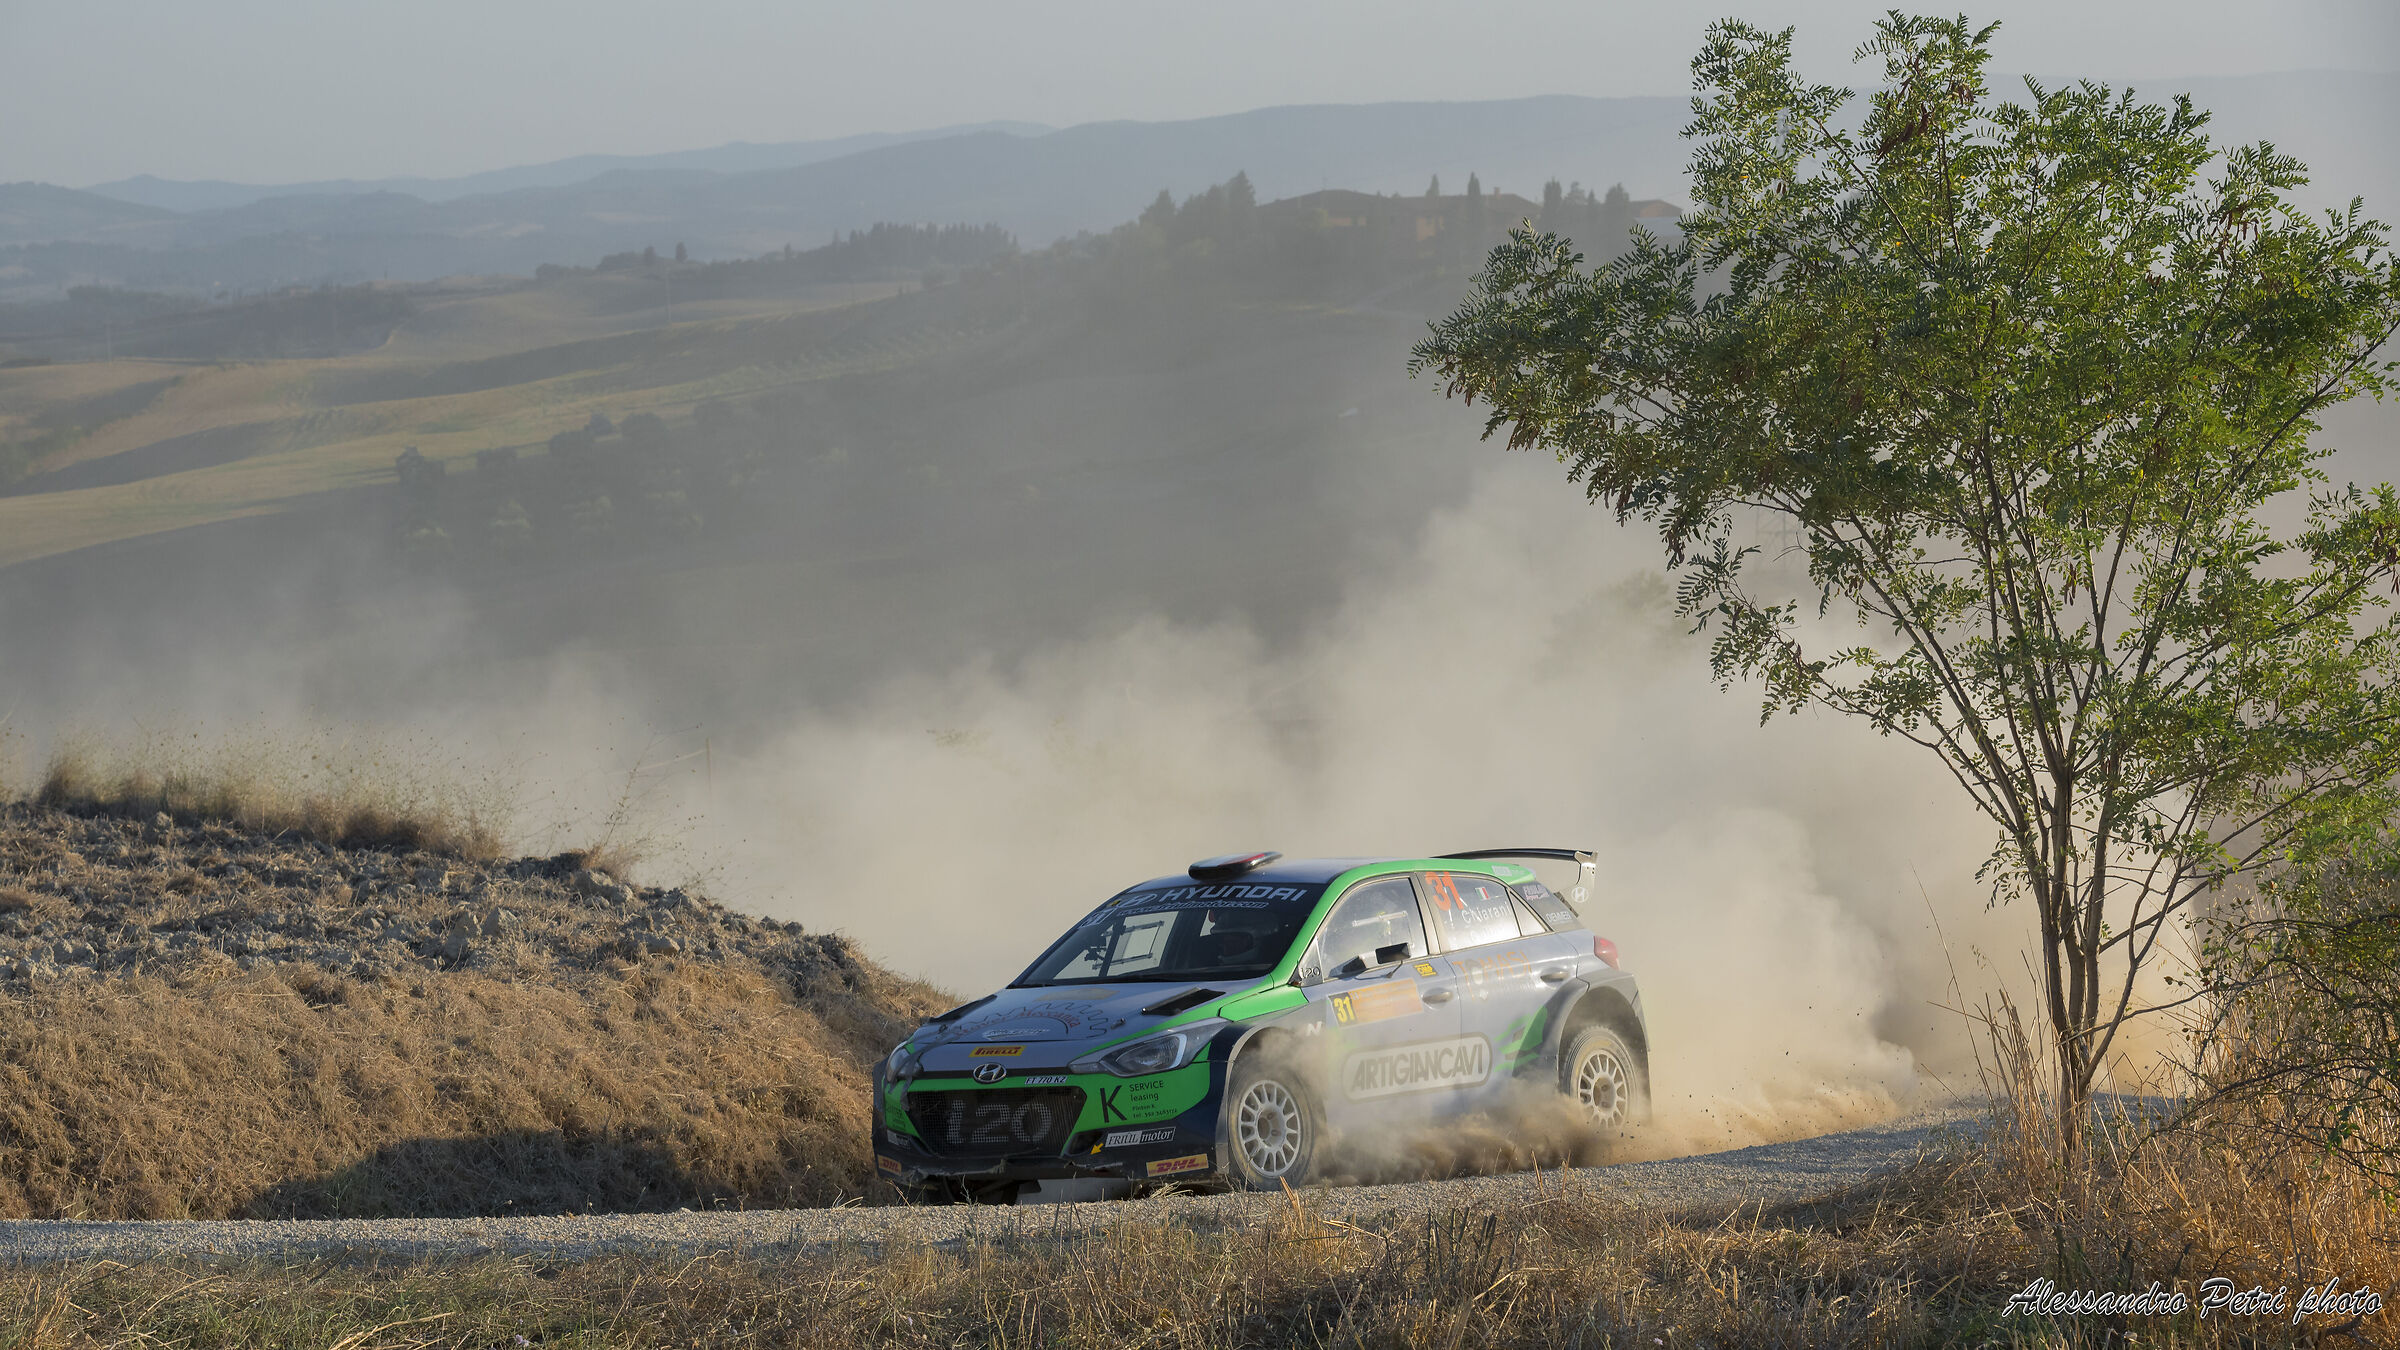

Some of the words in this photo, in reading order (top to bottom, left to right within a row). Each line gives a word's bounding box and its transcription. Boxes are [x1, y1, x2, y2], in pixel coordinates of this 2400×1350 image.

[1159, 885, 1307, 902] HYUNDAI
[1426, 872, 1464, 911] 31
[1334, 996, 1356, 1023] 31
[974, 1046, 1022, 1056] PIRELLI
[1351, 1043, 1484, 1091] ARTIGIANCAVI
[1129, 1080, 1164, 1092] SERVICE
[1100, 1085, 1127, 1123] K
[1130, 1092, 1159, 1103] leasing
[1141, 1129, 1173, 1142] motor
[1156, 1158, 1200, 1173] DHL
